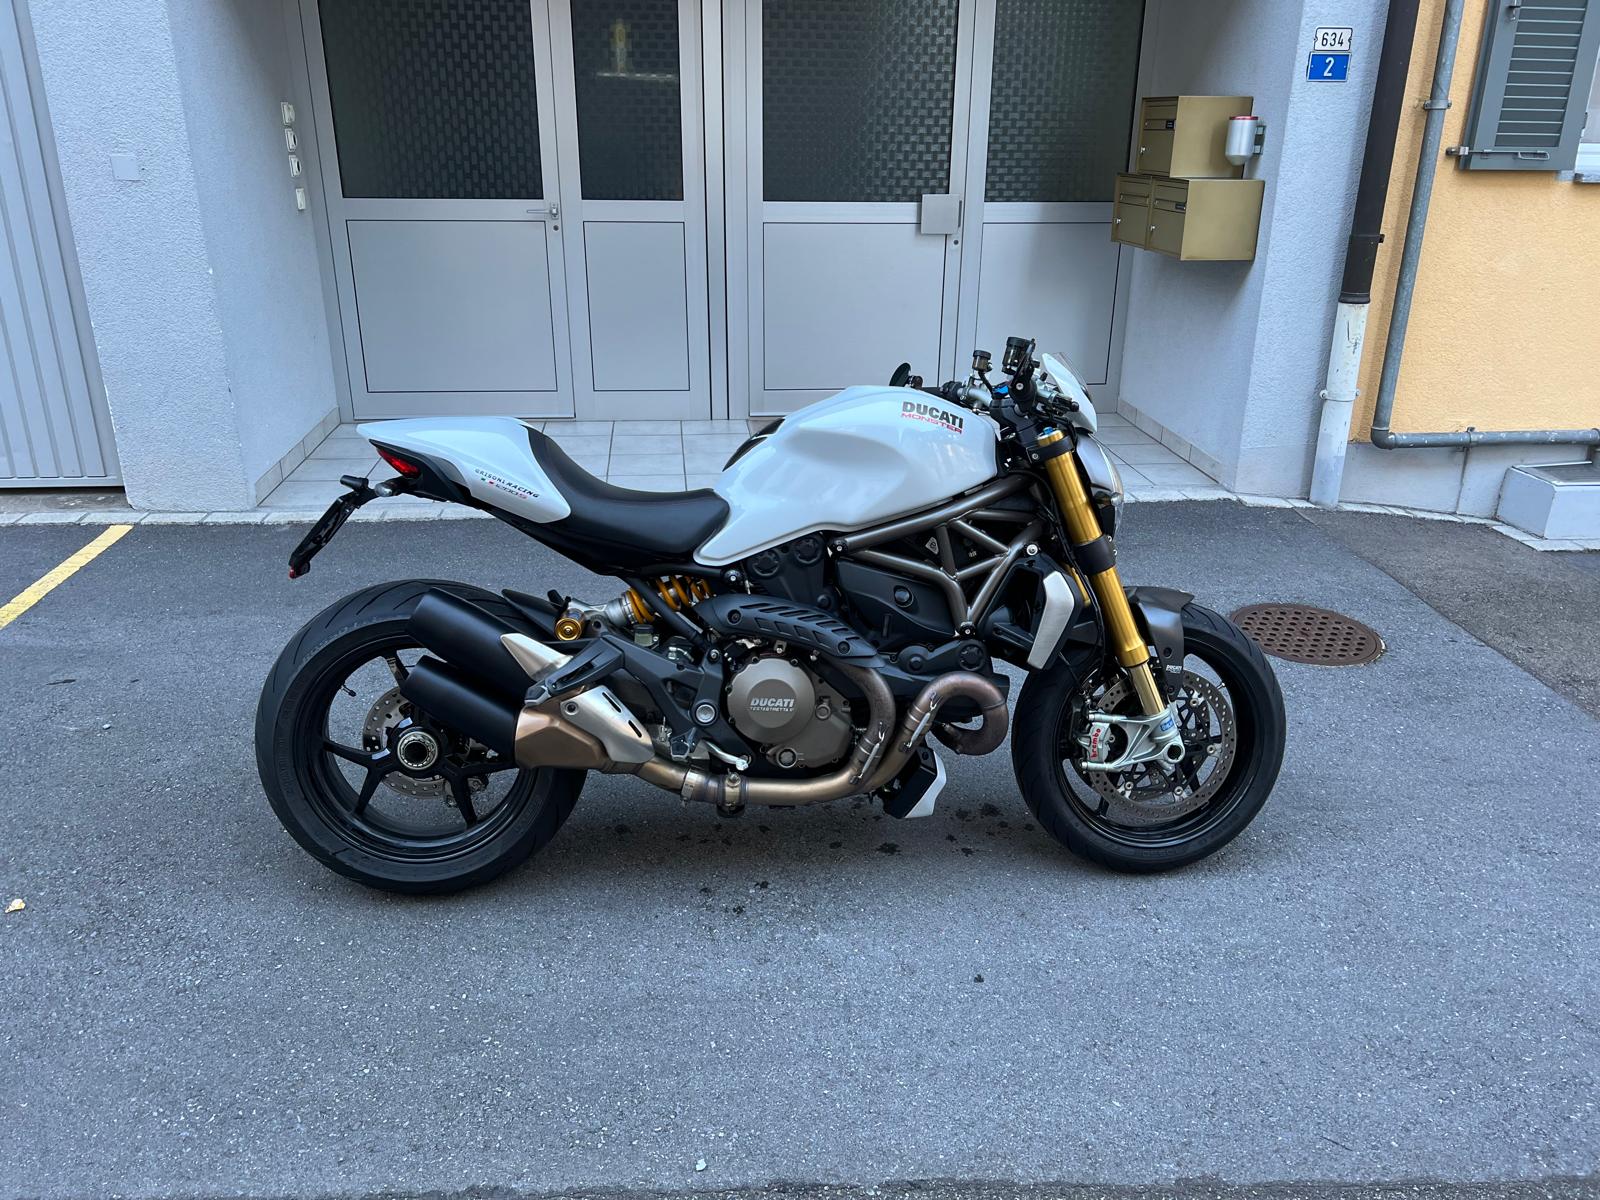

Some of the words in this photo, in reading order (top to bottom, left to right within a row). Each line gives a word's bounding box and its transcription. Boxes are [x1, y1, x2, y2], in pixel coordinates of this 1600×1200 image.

[1321, 32, 1344, 47] 634
[1323, 57, 1335, 77] 2
[901, 412, 962, 434] MONSTER
[902, 401, 964, 429] DUCATI
[506, 481, 540, 498] RACING
[750, 697, 795, 708] DUCATI
[1090, 728, 1102, 758] brembo
